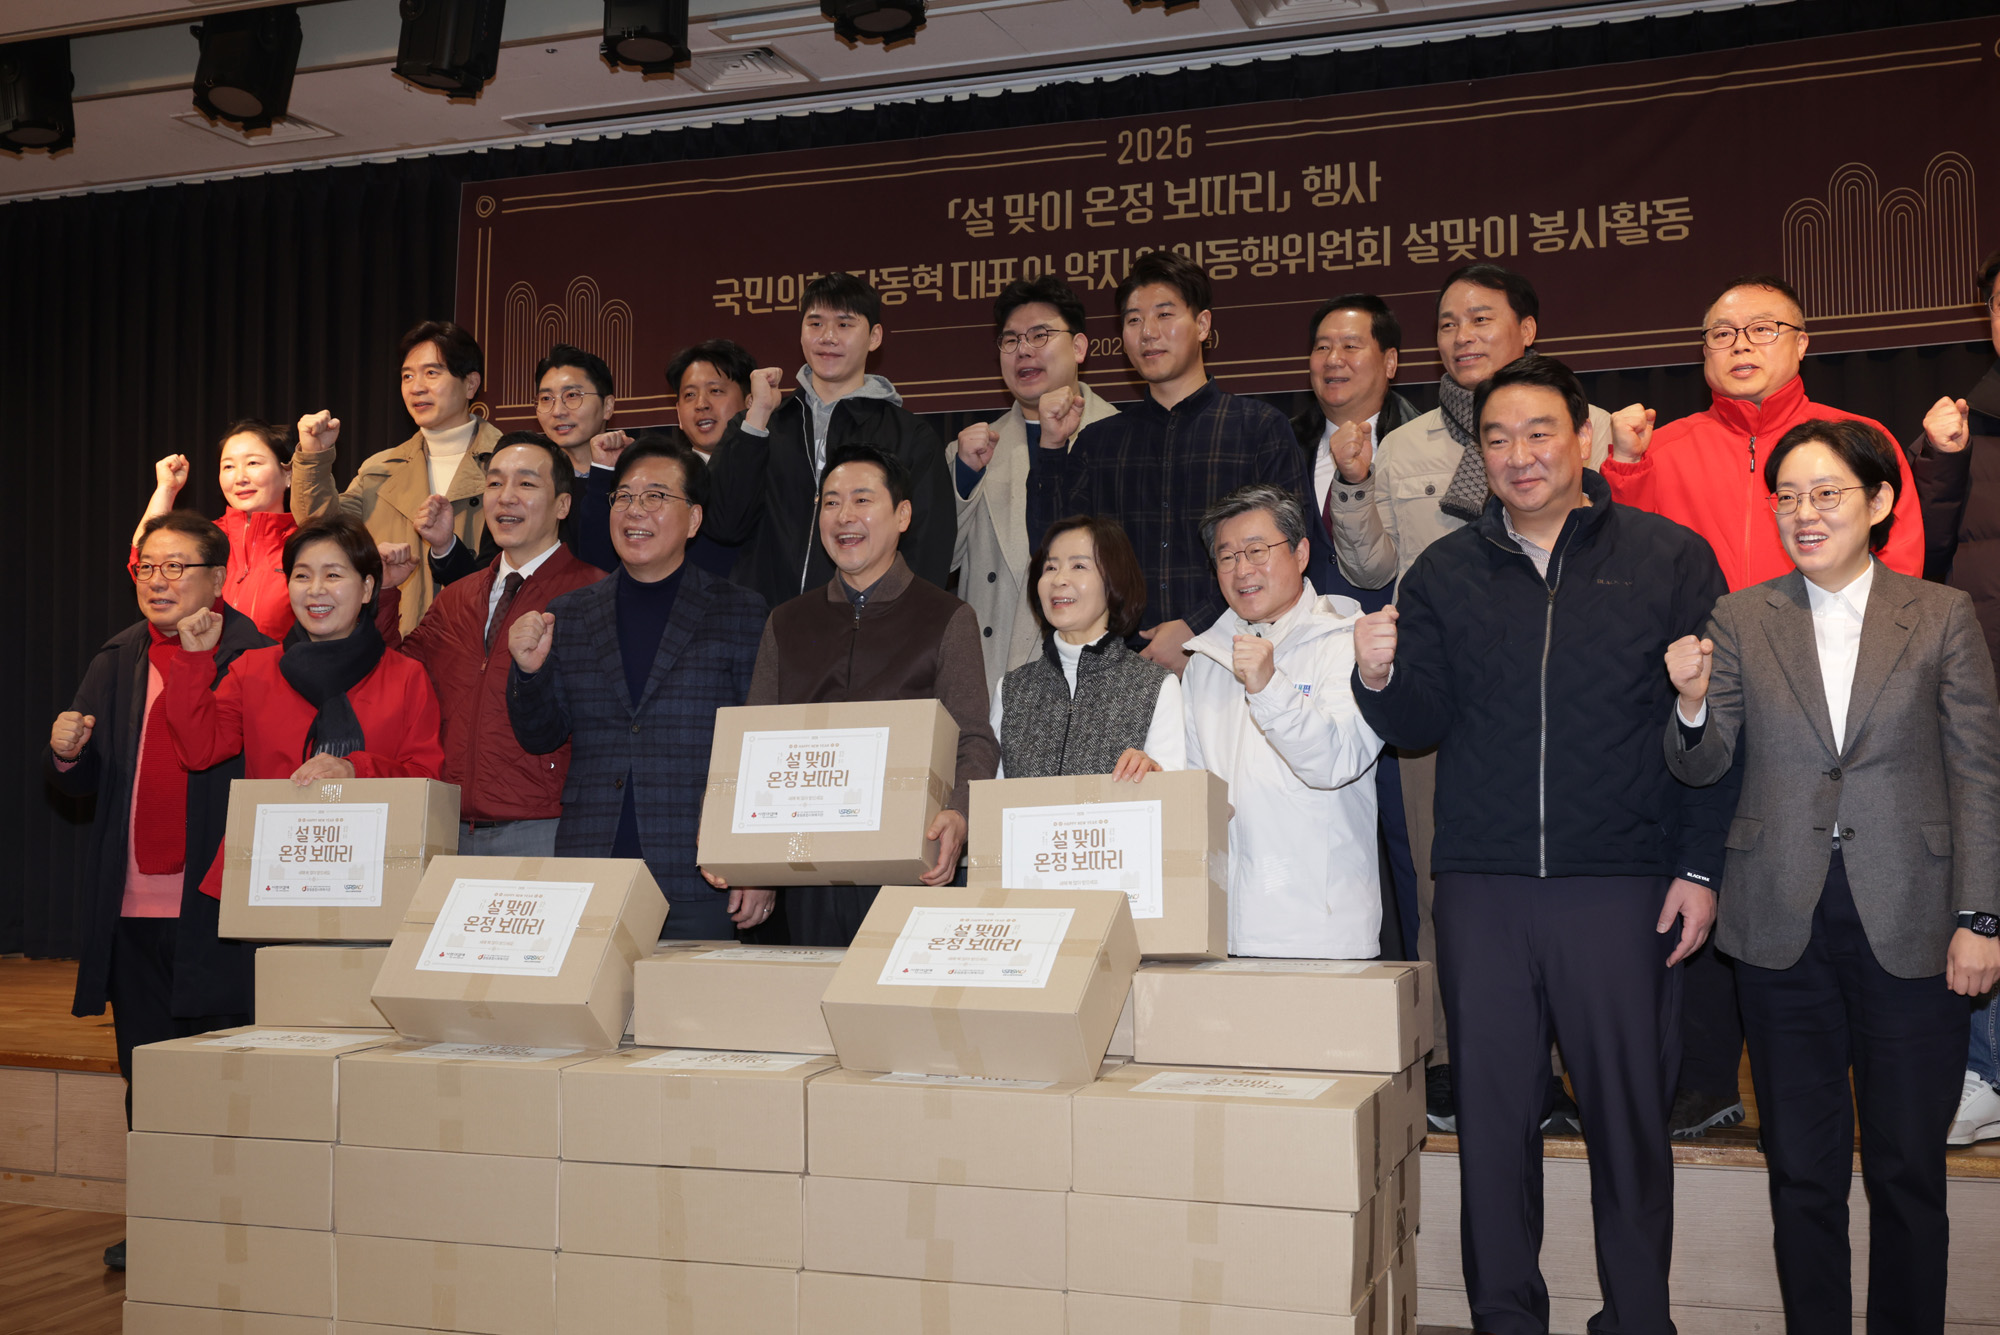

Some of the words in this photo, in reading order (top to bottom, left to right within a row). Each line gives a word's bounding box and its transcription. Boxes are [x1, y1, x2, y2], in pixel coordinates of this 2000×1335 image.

[1117, 124, 1192, 164] 2026
[1003, 189, 1072, 235] 맞이
[1082, 182, 1153, 227] 온정
[1302, 161, 1382, 207] 행사
[712, 272, 835, 316] 국민의
[1065, 225, 1391, 290] 약자동행위원회
[1402, 214, 1518, 264] 설맞이
[1529, 196, 1693, 253] 봉사활동
[786, 751, 801, 769] 설
[805, 750, 836, 769] 맞이
[766, 771, 798, 788] 온정
[800, 770, 849, 788] 보따리
[296, 826, 309, 843] 설
[313, 826, 340, 843] 맞이
[1052, 830, 1068, 850] 설
[1072, 828, 1105, 849] 맞이
[278, 845, 307, 863] 온정
[309, 845, 353, 863] 보따리
[1034, 852, 1067, 872] 온정
[1071, 849, 1123, 871] 보따리
[487, 899, 504, 915] 설
[505, 899, 537, 916] 맞이
[463, 916, 496, 933] 온정
[495, 917, 545, 935] 보따리
[954, 924, 972, 937] 설
[976, 924, 1011, 938] 맞이
[928, 937, 964, 951] 온정
[964, 938, 1022, 951] 보따리
